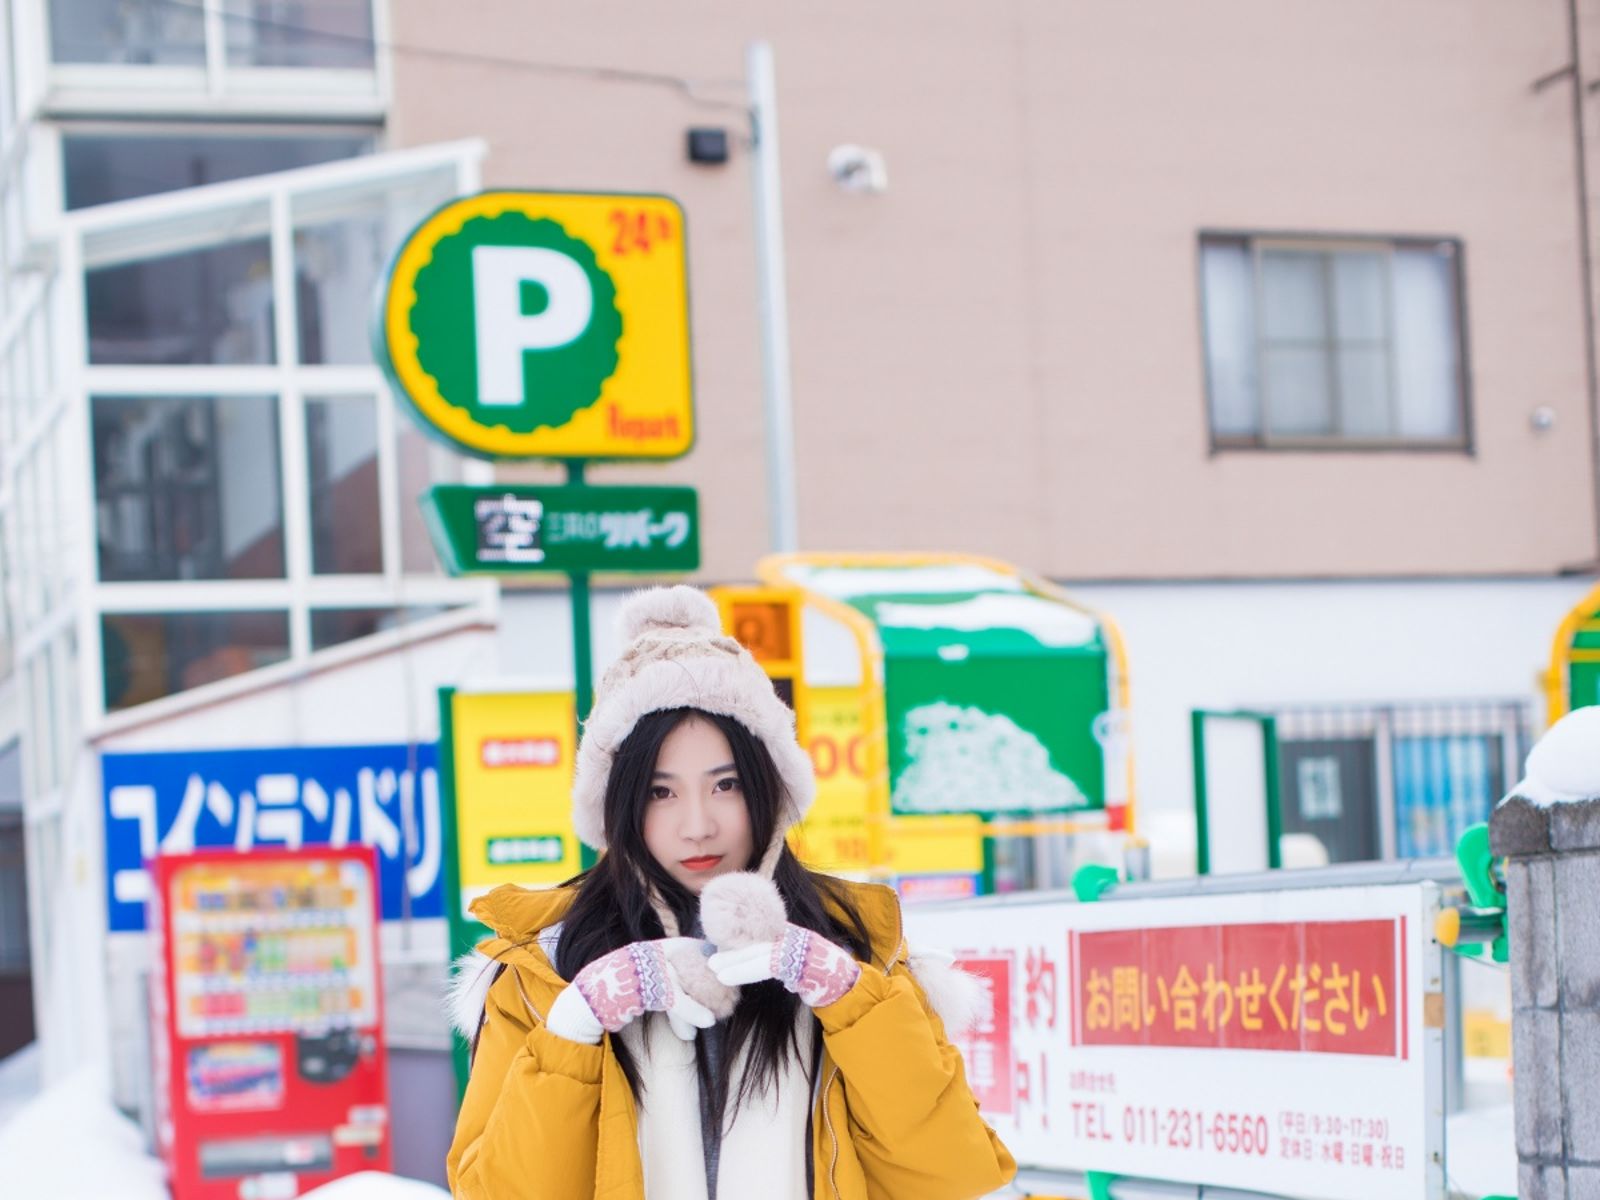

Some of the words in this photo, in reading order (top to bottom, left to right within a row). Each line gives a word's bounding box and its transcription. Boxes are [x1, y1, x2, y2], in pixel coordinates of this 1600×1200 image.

[471, 243, 595, 407] P
[474, 492, 546, 564] 空
[1084, 961, 1389, 1036] お問い合わせください
[1071, 1102, 1113, 1141] TEL
[1122, 1105, 1269, 1157] 011-231-6560
